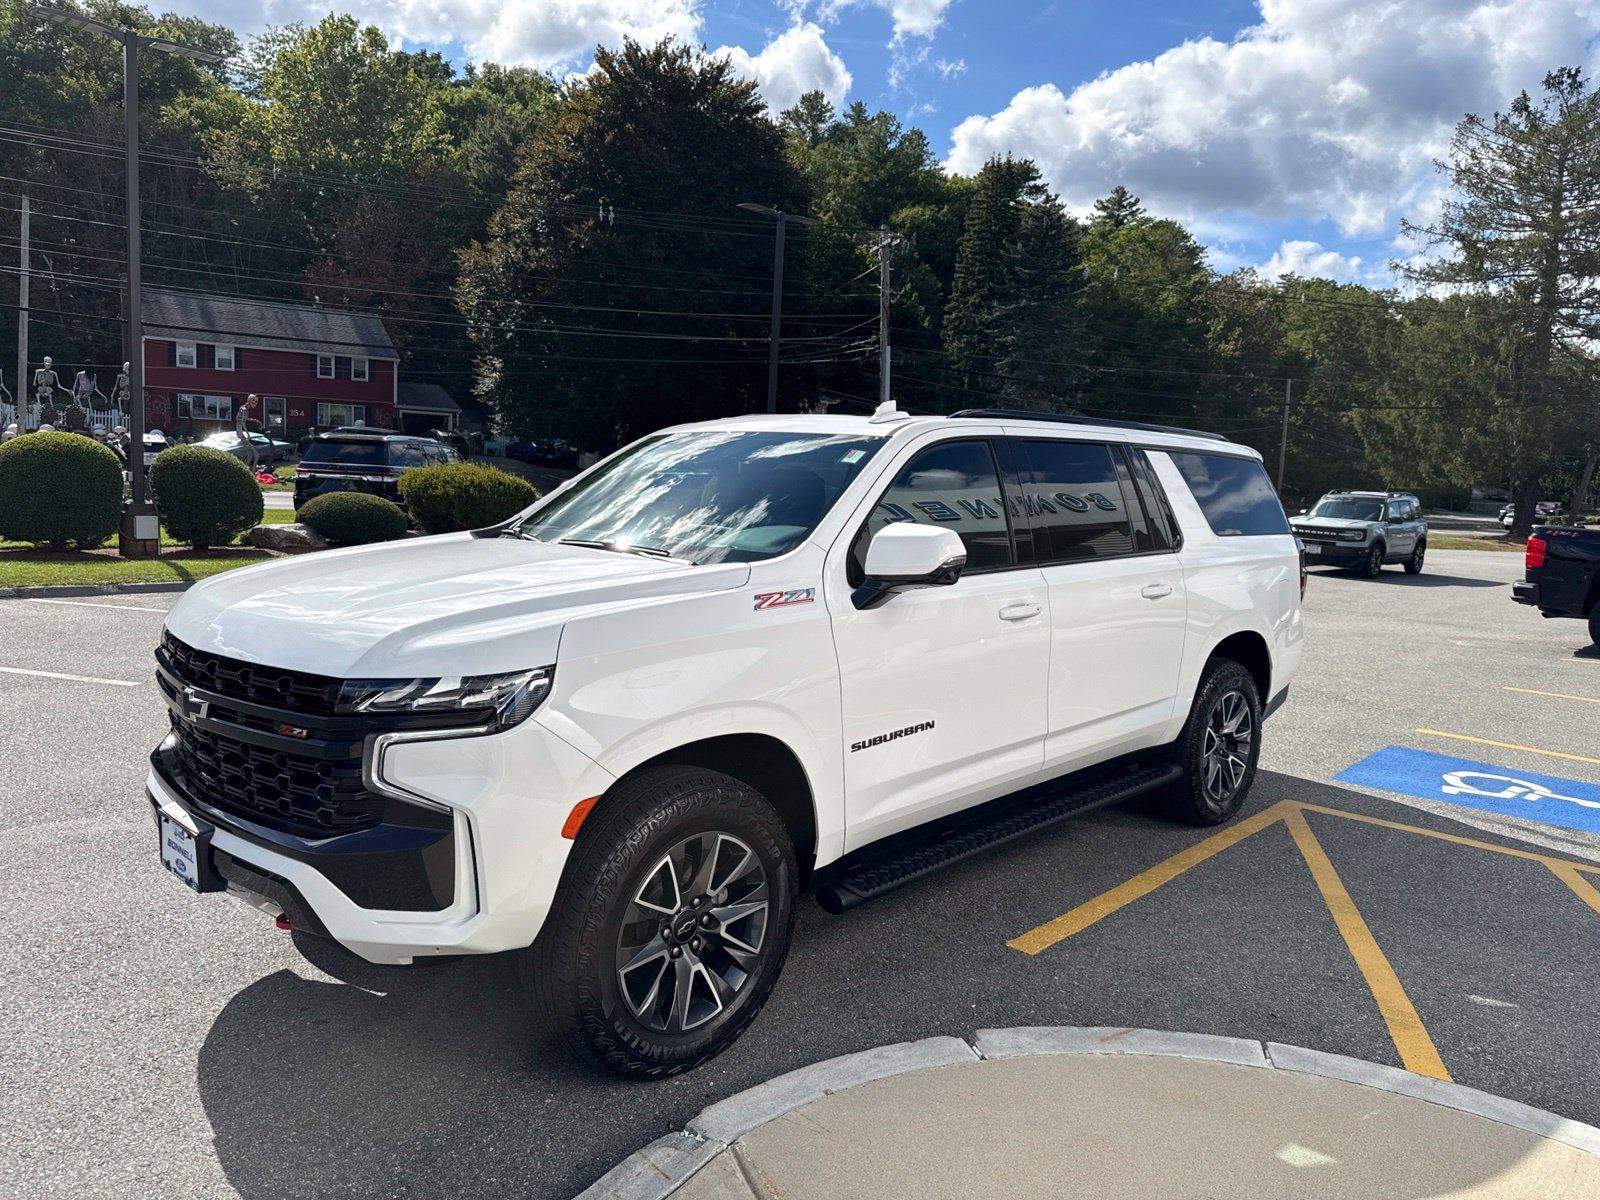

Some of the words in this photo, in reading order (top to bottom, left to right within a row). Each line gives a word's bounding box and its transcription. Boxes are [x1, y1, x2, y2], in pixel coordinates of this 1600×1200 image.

[289, 408, 305, 417] 354
[753, 587, 815, 611] Z71
[278, 724, 308, 739] Z71
[850, 719, 936, 753] SUBURBAN
[167, 837, 195, 864] BONNELL
